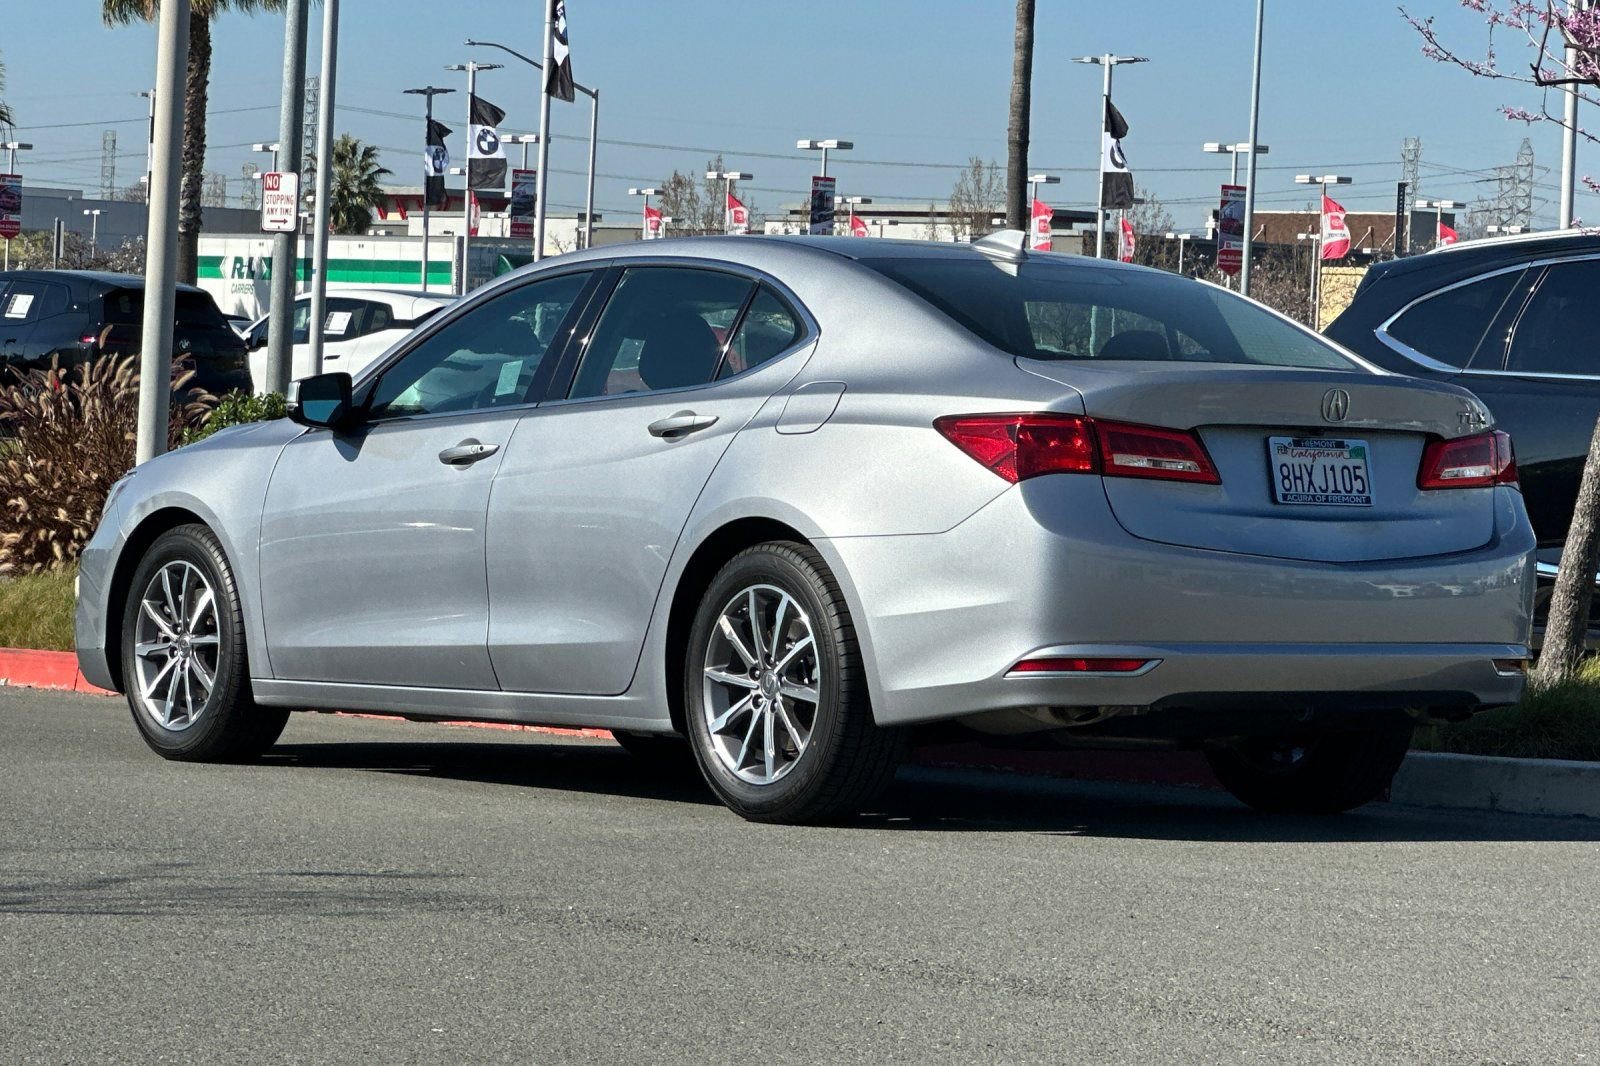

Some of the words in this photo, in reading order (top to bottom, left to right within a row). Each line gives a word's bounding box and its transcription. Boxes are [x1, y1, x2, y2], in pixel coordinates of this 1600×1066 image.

[266, 175, 279, 189] NO
[266, 194, 294, 205] STOPPING
[266, 207, 279, 216] ANY
[280, 208, 293, 217] TIME
[230, 283, 255, 295] CARRIERS
[1301, 440, 1337, 448] FREMONT
[1290, 448, 1345, 463] California
[1280, 463, 1366, 494] 8HXJ105
[1315, 495, 1326, 503] OF
[1328, 495, 1367, 504] FREMONT
